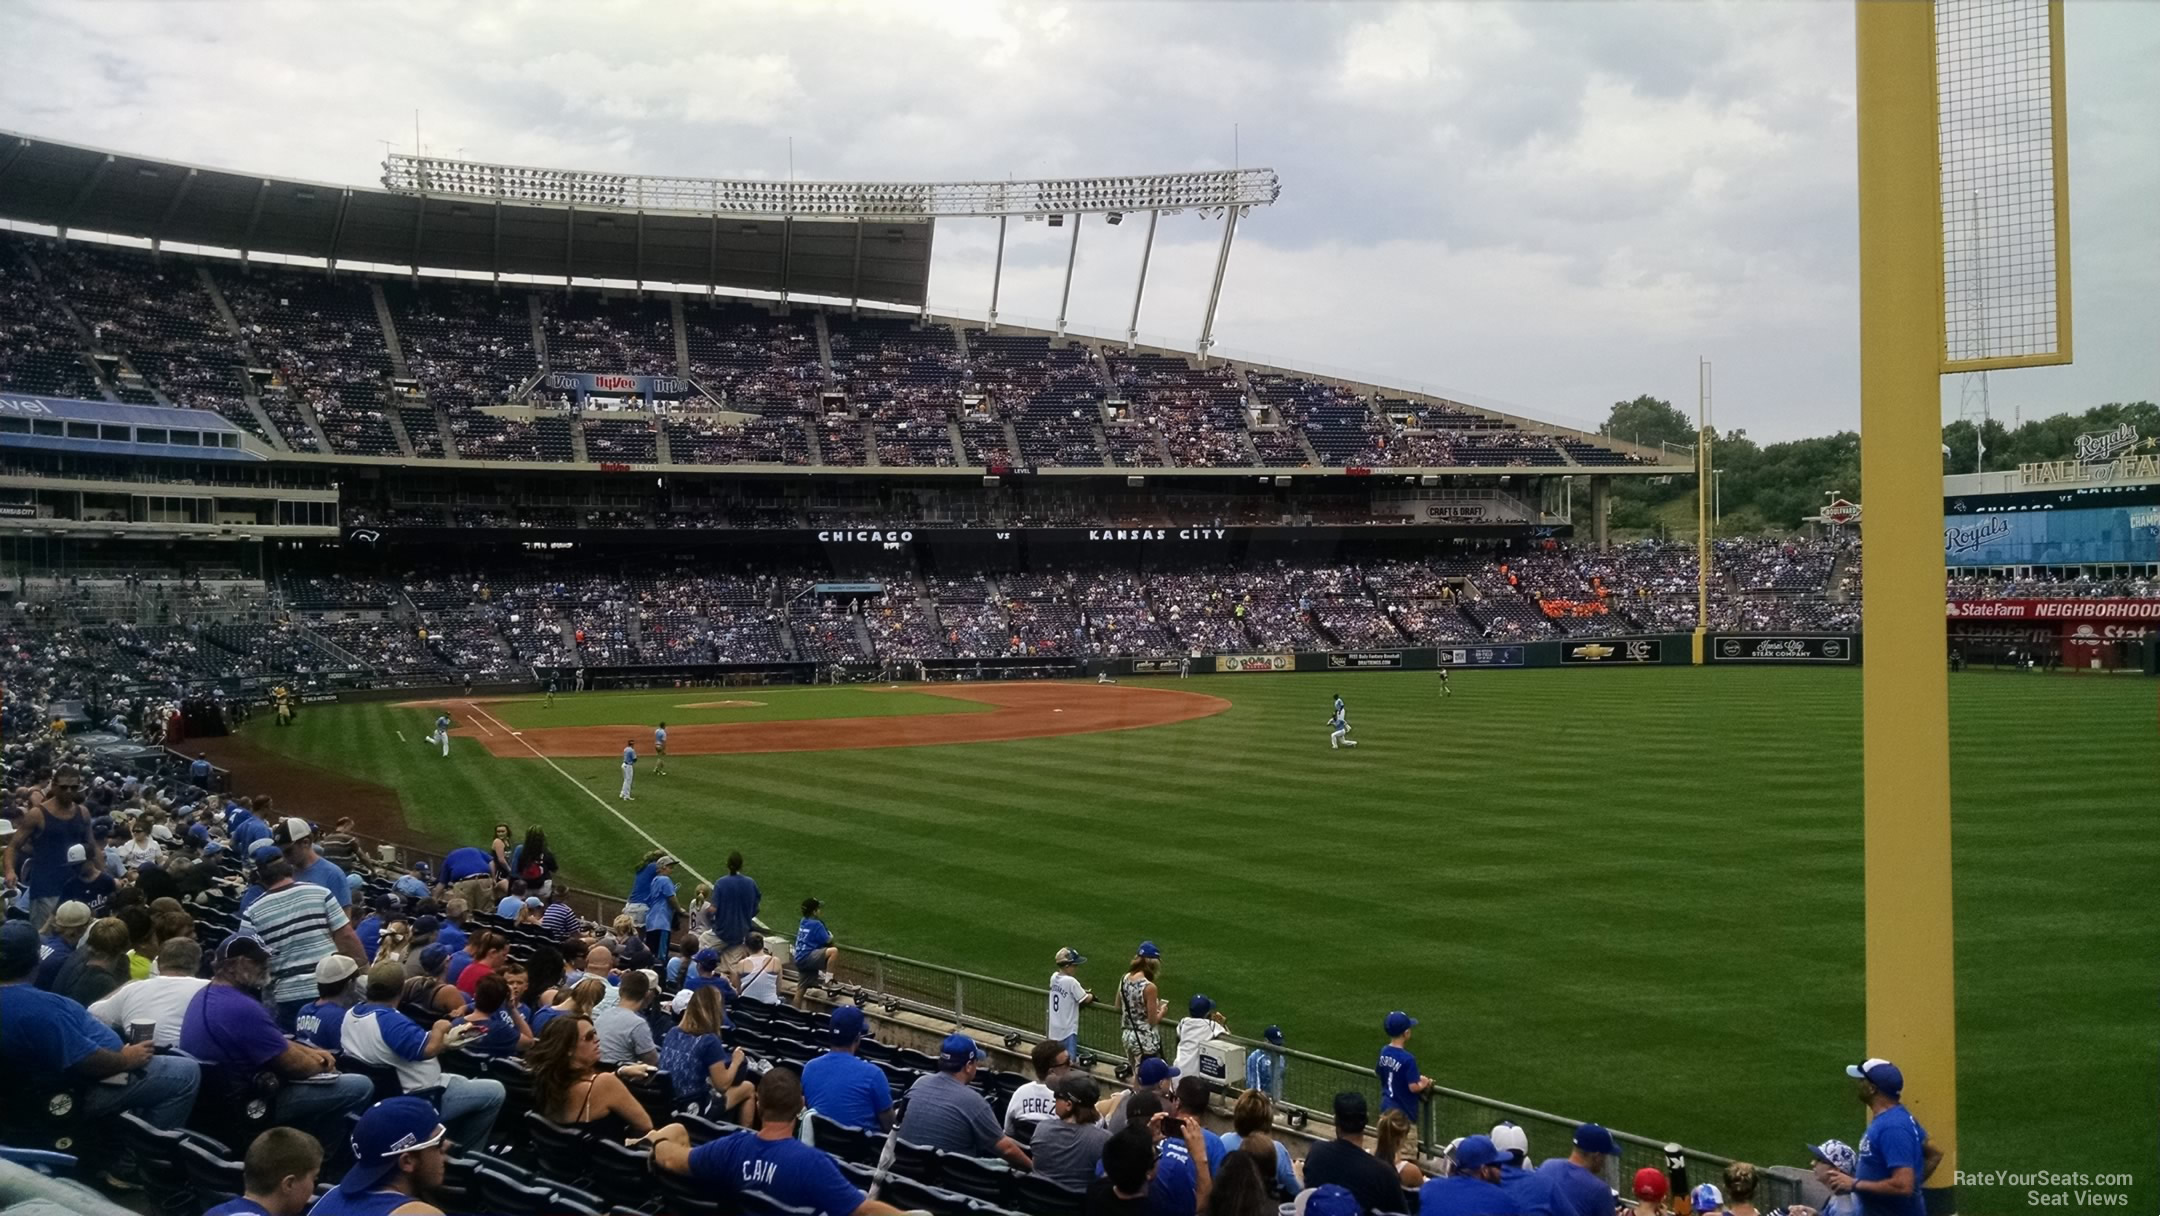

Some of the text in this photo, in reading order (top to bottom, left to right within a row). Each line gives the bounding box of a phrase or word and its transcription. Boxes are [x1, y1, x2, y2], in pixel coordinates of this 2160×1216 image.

[595, 376, 636, 391] HyVee
[2074, 422, 2139, 459] Royals
[2019, 459, 2090, 485] HALL
[2095, 460, 2119, 484] of
[1429, 507, 1482, 516] CRAFT & DRAFT
[2130, 515, 2160, 528] CHAMP
[818, 531, 913, 542] CHICAGO
[1089, 530, 1166, 541] KANSAS
[1179, 529, 1225, 540] CITY
[1944, 516, 2010, 554] Royals
[2035, 603, 2160, 617] NEIGHBORHOOD
[1626, 641, 1651, 661] KC
[1757, 640, 1805, 652] Kansas City
[1240, 656, 1272, 667] ROMA
[1053, 994, 1060, 1012] 8
[1022, 1097, 1057, 1116] PEREZ
[742, 1159, 778, 1185] CAIN
